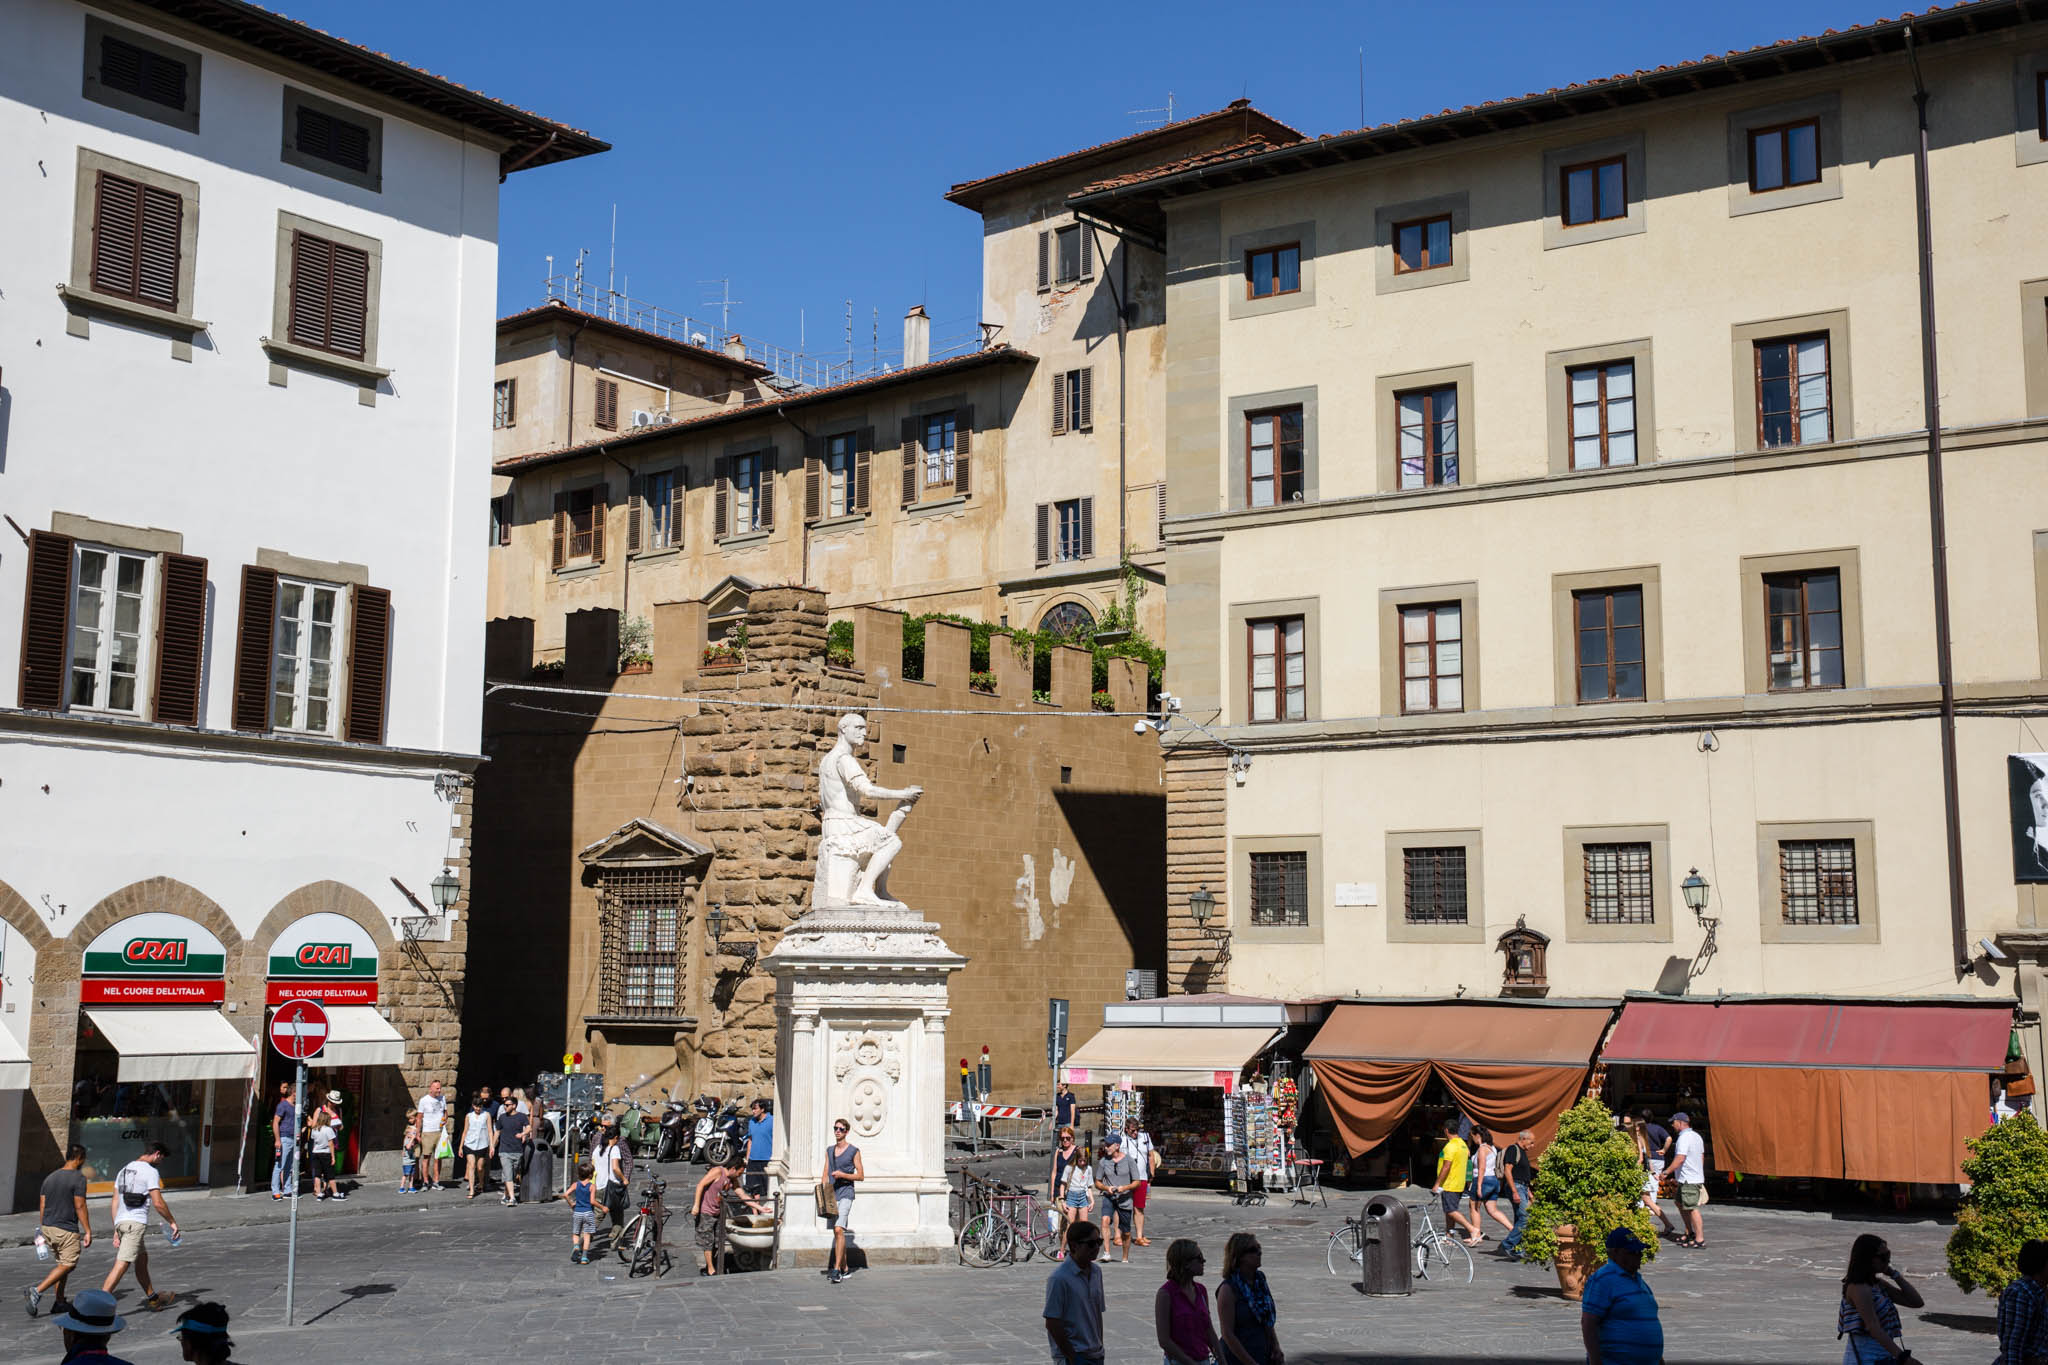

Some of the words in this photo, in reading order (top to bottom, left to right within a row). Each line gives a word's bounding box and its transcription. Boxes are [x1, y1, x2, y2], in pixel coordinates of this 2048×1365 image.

[127, 940, 185, 961] CRAI
[299, 945, 350, 964] CRAI
[103, 987, 121, 995] NEL
[123, 987, 154, 996] CUORE
[156, 987, 206, 996] DELL'ITALIA
[296, 989, 323, 998] CUORE
[324, 989, 368, 998] DELL'ITALIA
